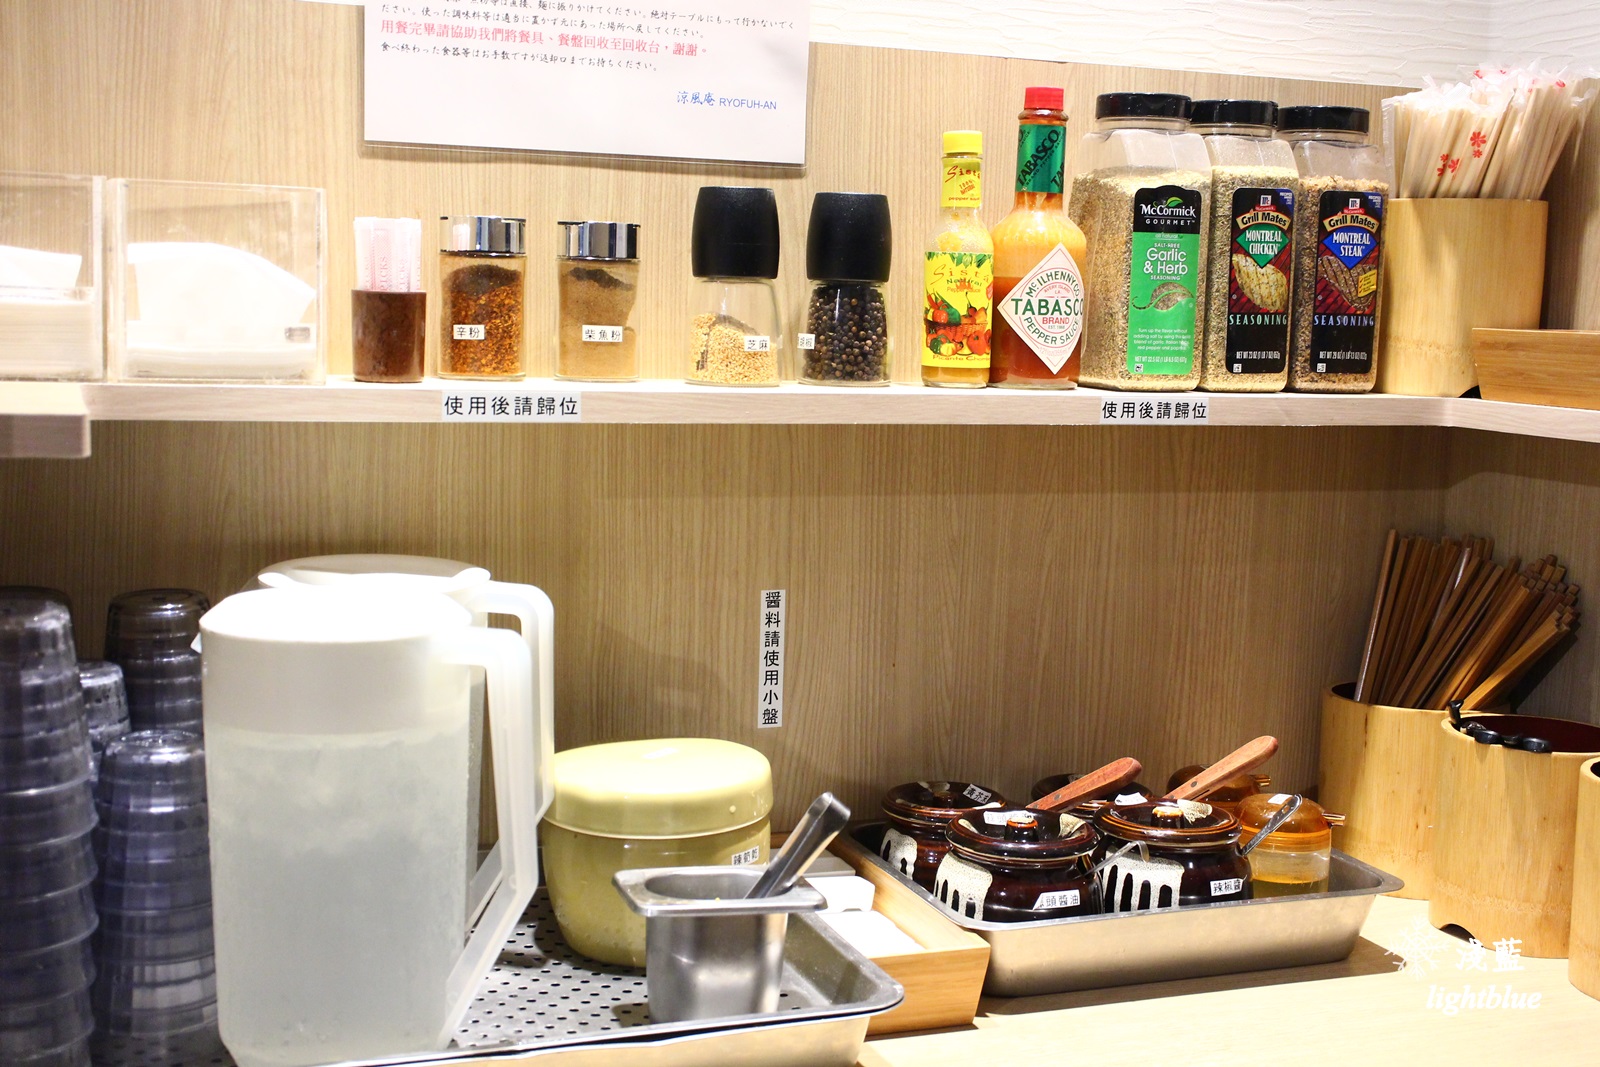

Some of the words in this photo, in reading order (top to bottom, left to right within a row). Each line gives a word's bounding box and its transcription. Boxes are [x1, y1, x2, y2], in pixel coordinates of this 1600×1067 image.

[677, 91, 715, 106] 涼風庵
[719, 98, 777, 110] RYOFUH-AN
[1017, 129, 1059, 186] TABASCO
[1140, 204, 1196, 218] McCormick
[1241, 212, 1259, 225] Grill
[1262, 212, 1287, 226] Mates
[1328, 214, 1348, 228] Grill
[1350, 215, 1375, 230] Mates
[1246, 230, 1282, 242] MONTREAL
[1332, 232, 1370, 244] MONTREAL
[1146, 248, 1186, 262] Garlic
[1249, 243, 1278, 254] CHICKEN
[1340, 245, 1362, 256] STEAK
[1144, 260, 1154, 274] &
[1157, 262, 1188, 274] Herb
[1042, 316, 1070, 325] BRAND
[1228, 314, 1287, 326] SEASONING
[1314, 315, 1374, 326] SEASONING
[456, 327, 480, 339] 辛粉
[584, 329, 621, 342] 柴魚粉
[1024, 316, 1057, 345] PEPPER
[444, 396, 578, 416] 使用後請歸位
[1102, 401, 1207, 420] 使用後請歸位
[762, 591, 782, 725] 醬料請使用小盤
